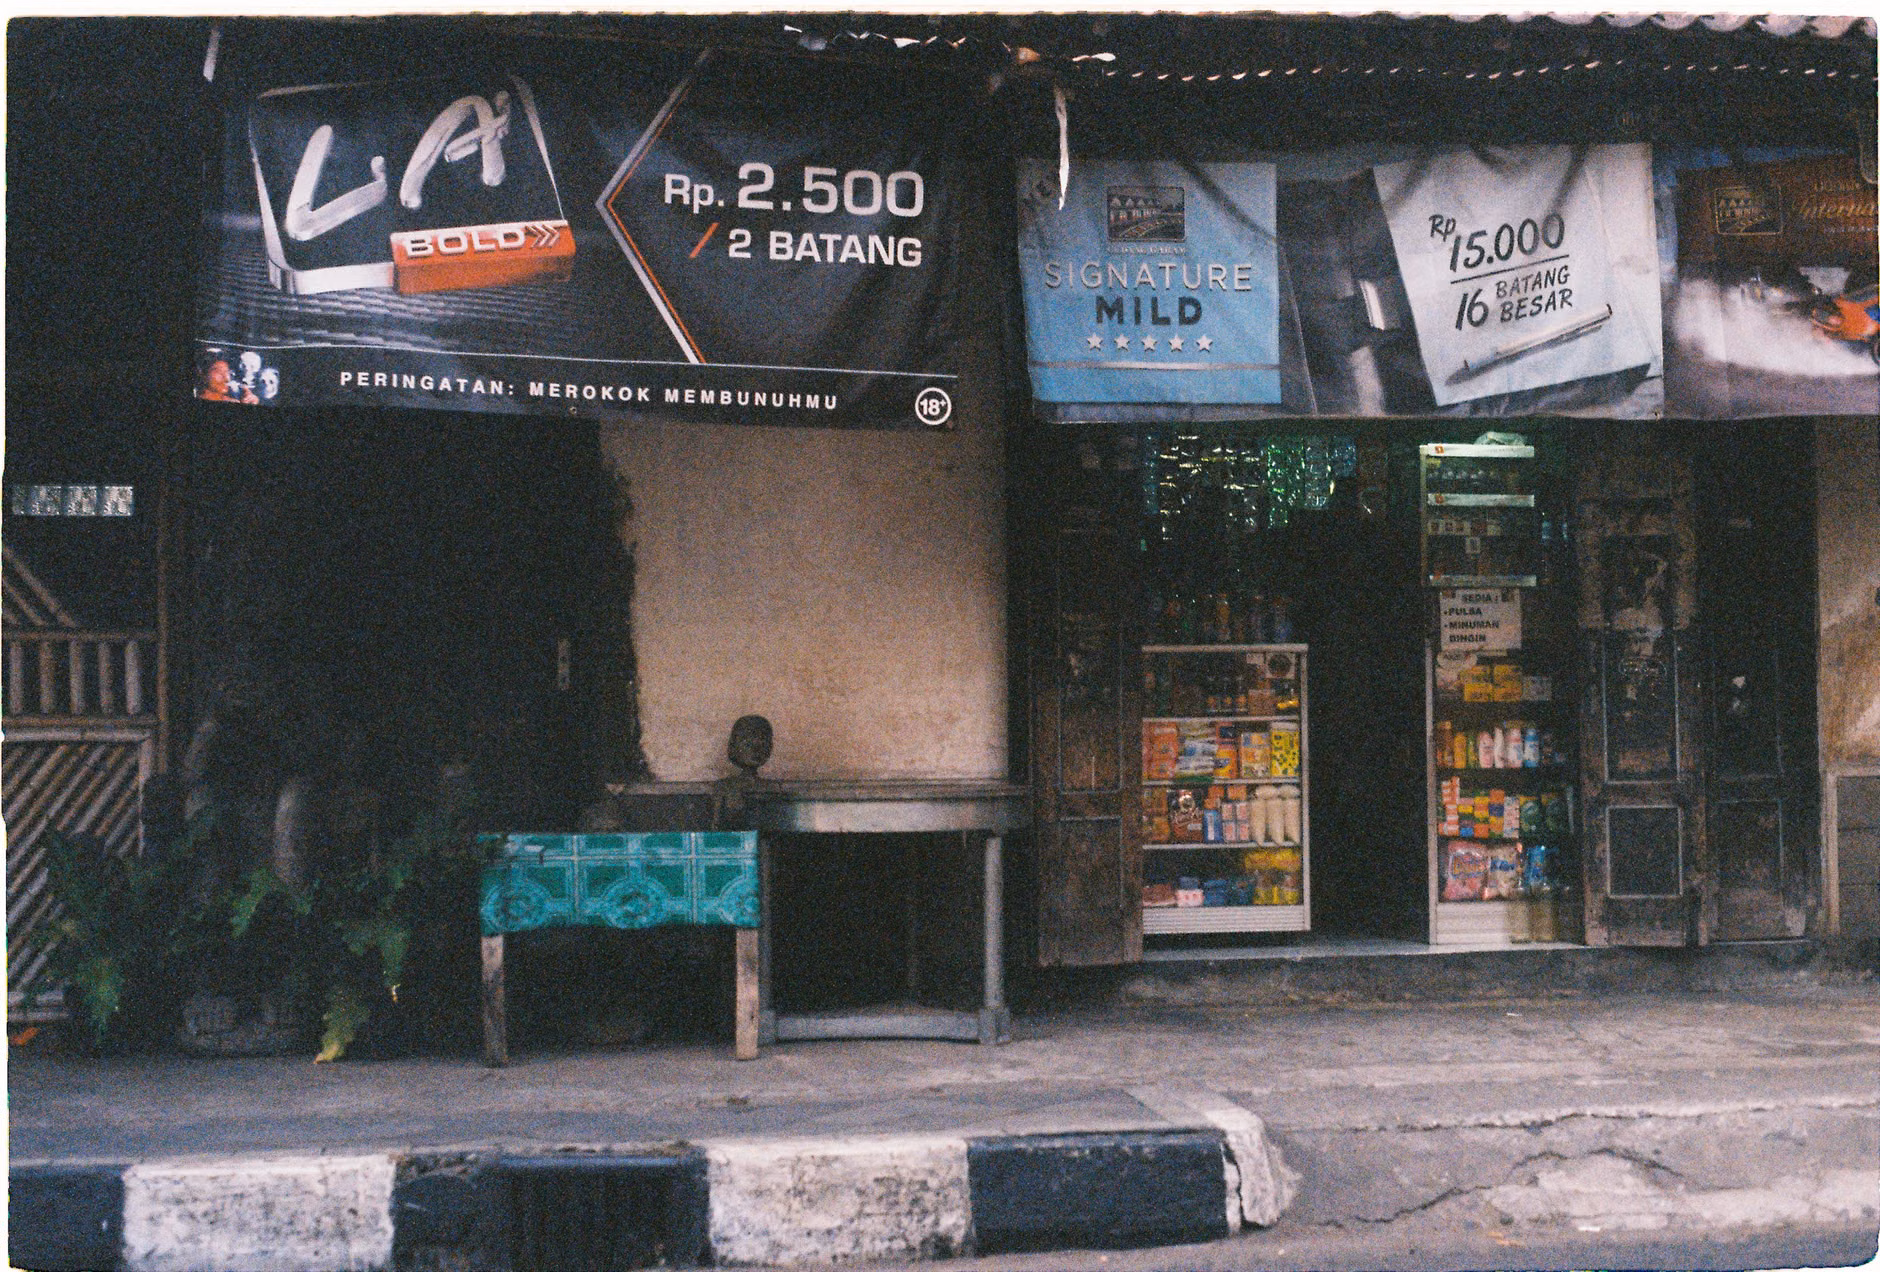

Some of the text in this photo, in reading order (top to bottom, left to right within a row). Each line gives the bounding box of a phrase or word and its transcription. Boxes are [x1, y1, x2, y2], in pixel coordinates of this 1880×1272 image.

[285, 92, 510, 241] LA
[664, 162, 925, 217] Rp. 2.500
[406, 228, 526, 258] BOLD
[728, 228, 752, 258] 2
[769, 230, 923, 267] BATANG
[1428, 212, 1565, 273] Rp 15.000
[1044, 262, 1252, 292] SIGNATURE
[1495, 264, 1571, 299] BATANG
[1095, 295, 1203, 326] MILD
[1455, 288, 1489, 331] 16
[1500, 288, 1573, 323] BESAR
[340, 371, 838, 410] PERINGATAN: MEROKOK MEMBUNUHMU
